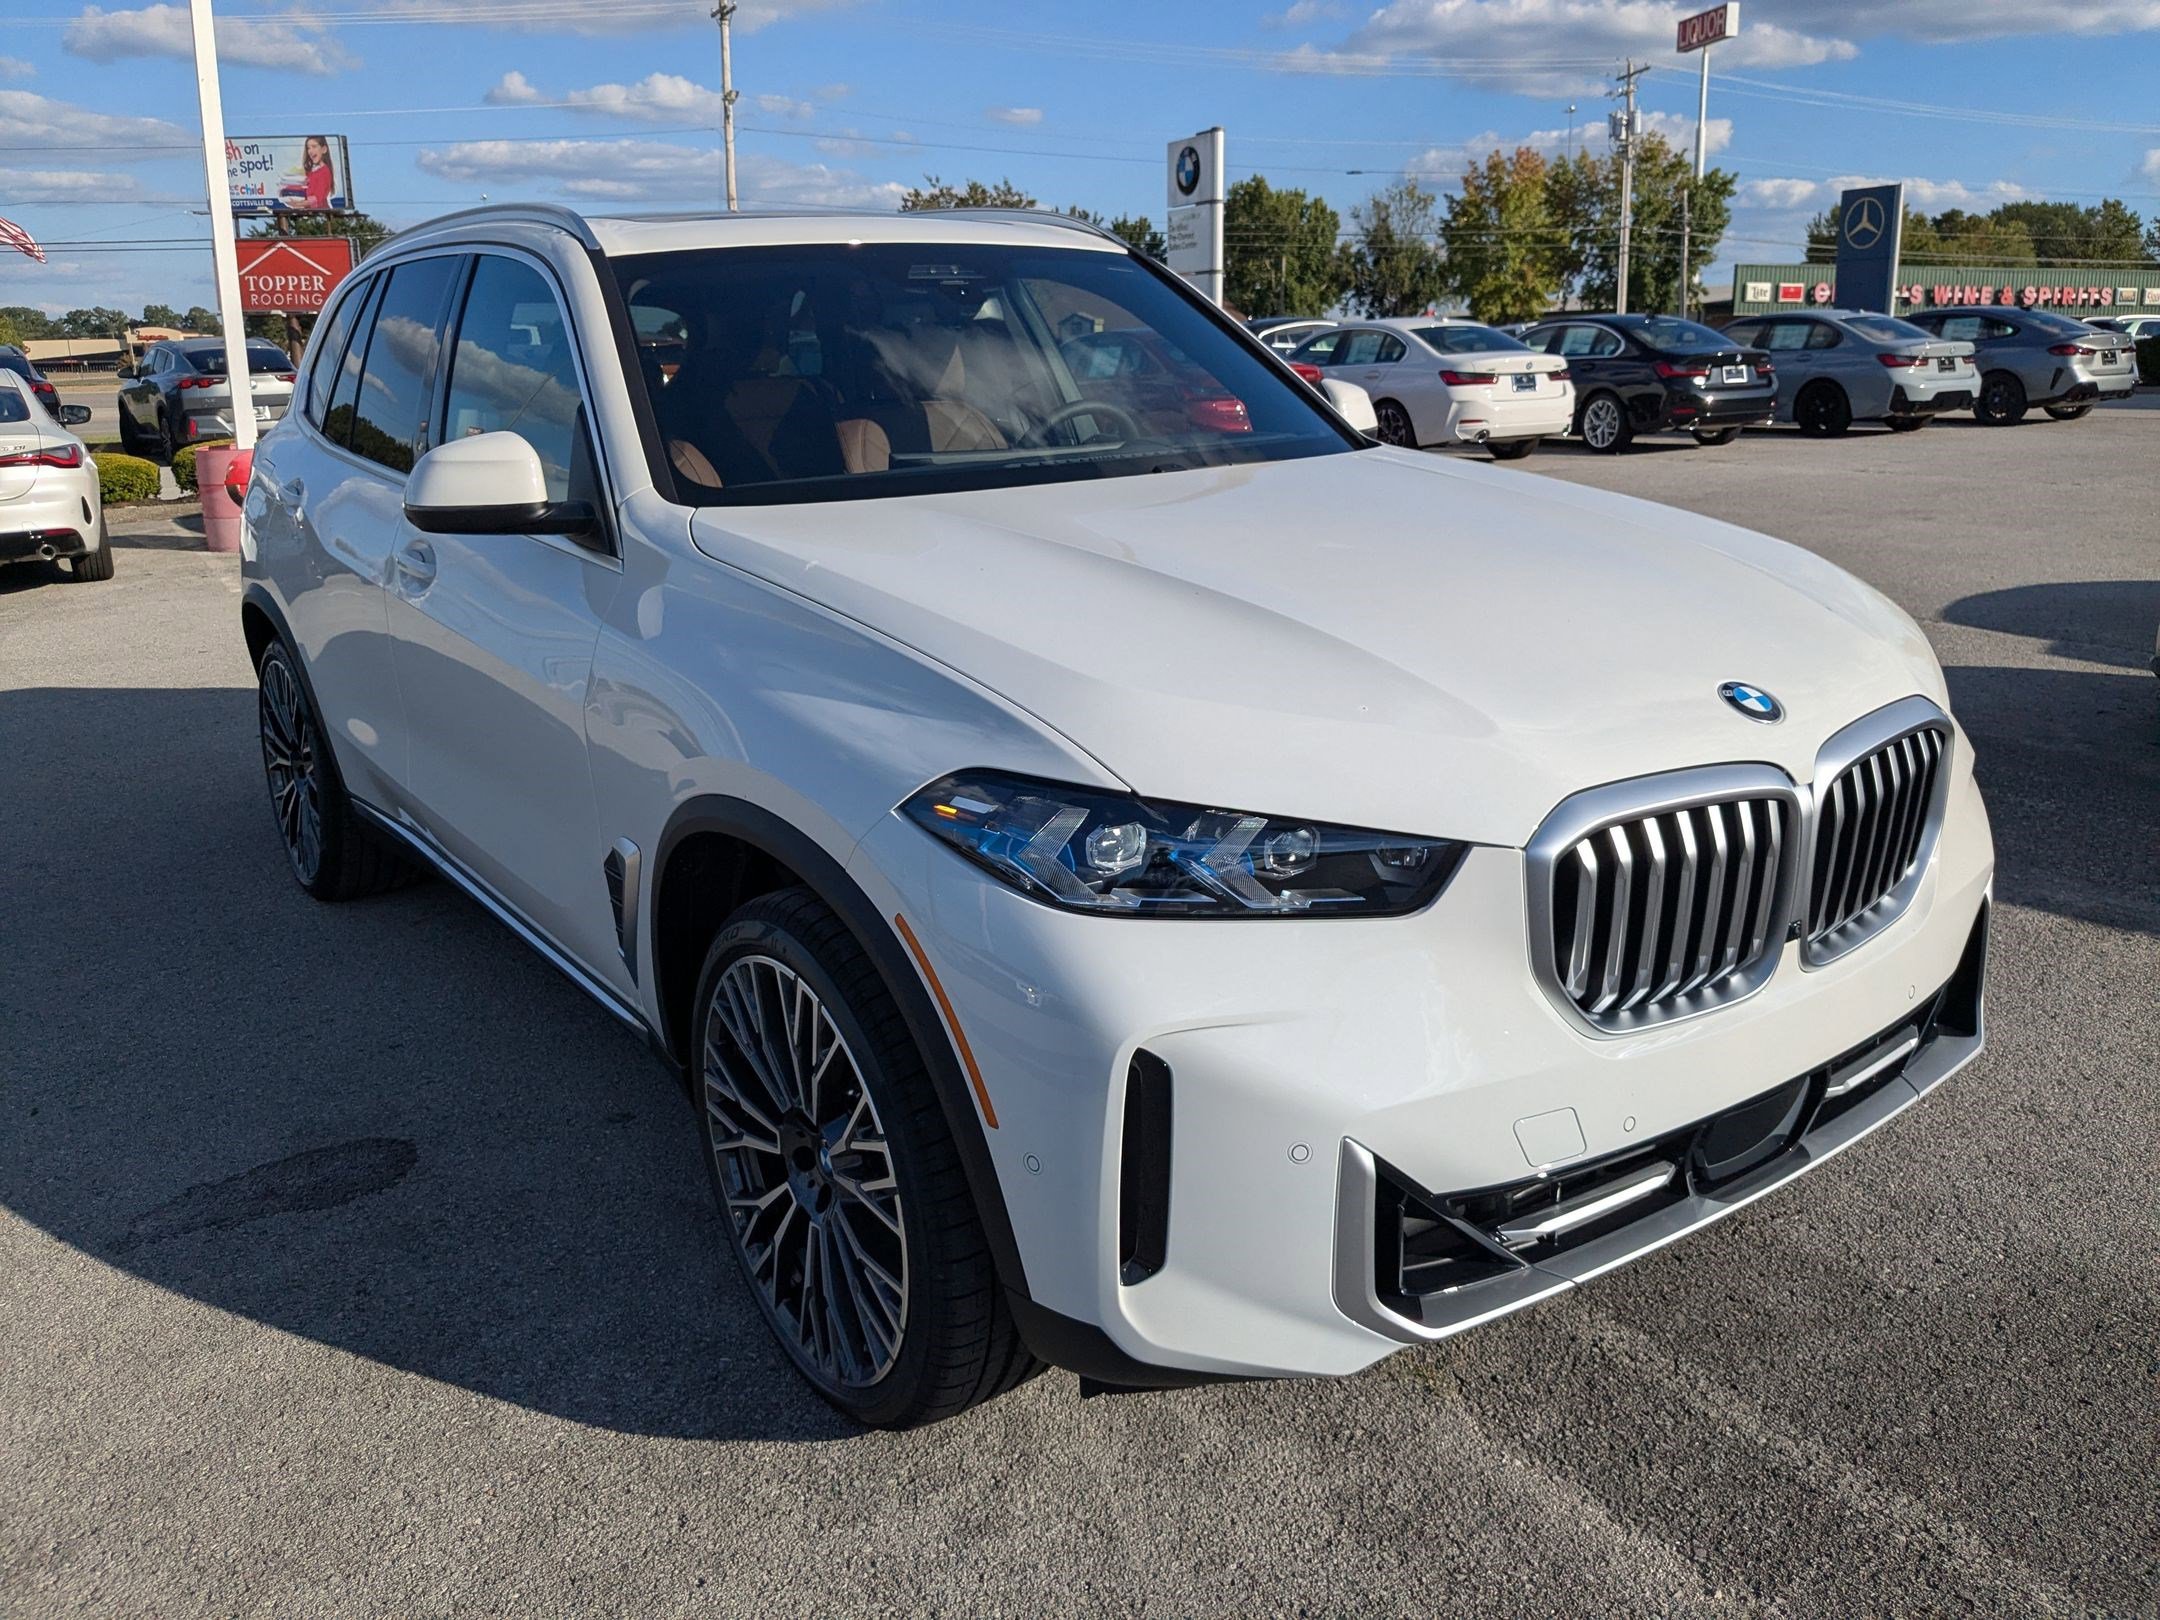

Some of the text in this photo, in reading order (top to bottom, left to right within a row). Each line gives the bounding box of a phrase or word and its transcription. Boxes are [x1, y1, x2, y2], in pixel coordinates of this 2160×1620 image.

[1679, 8, 1725, 47] LIQUOR
[244, 143, 259, 155] on
[240, 154, 273, 178] spot!
[240, 182, 264, 195] child
[245, 275, 326, 291] TOPPER
[251, 293, 323, 306] ROOFING
[1751, 286, 1768, 299] Lite
[1934, 285, 1993, 305] WINE
[2001, 285, 2015, 305] &
[2023, 285, 2113, 306] SPIRITS
